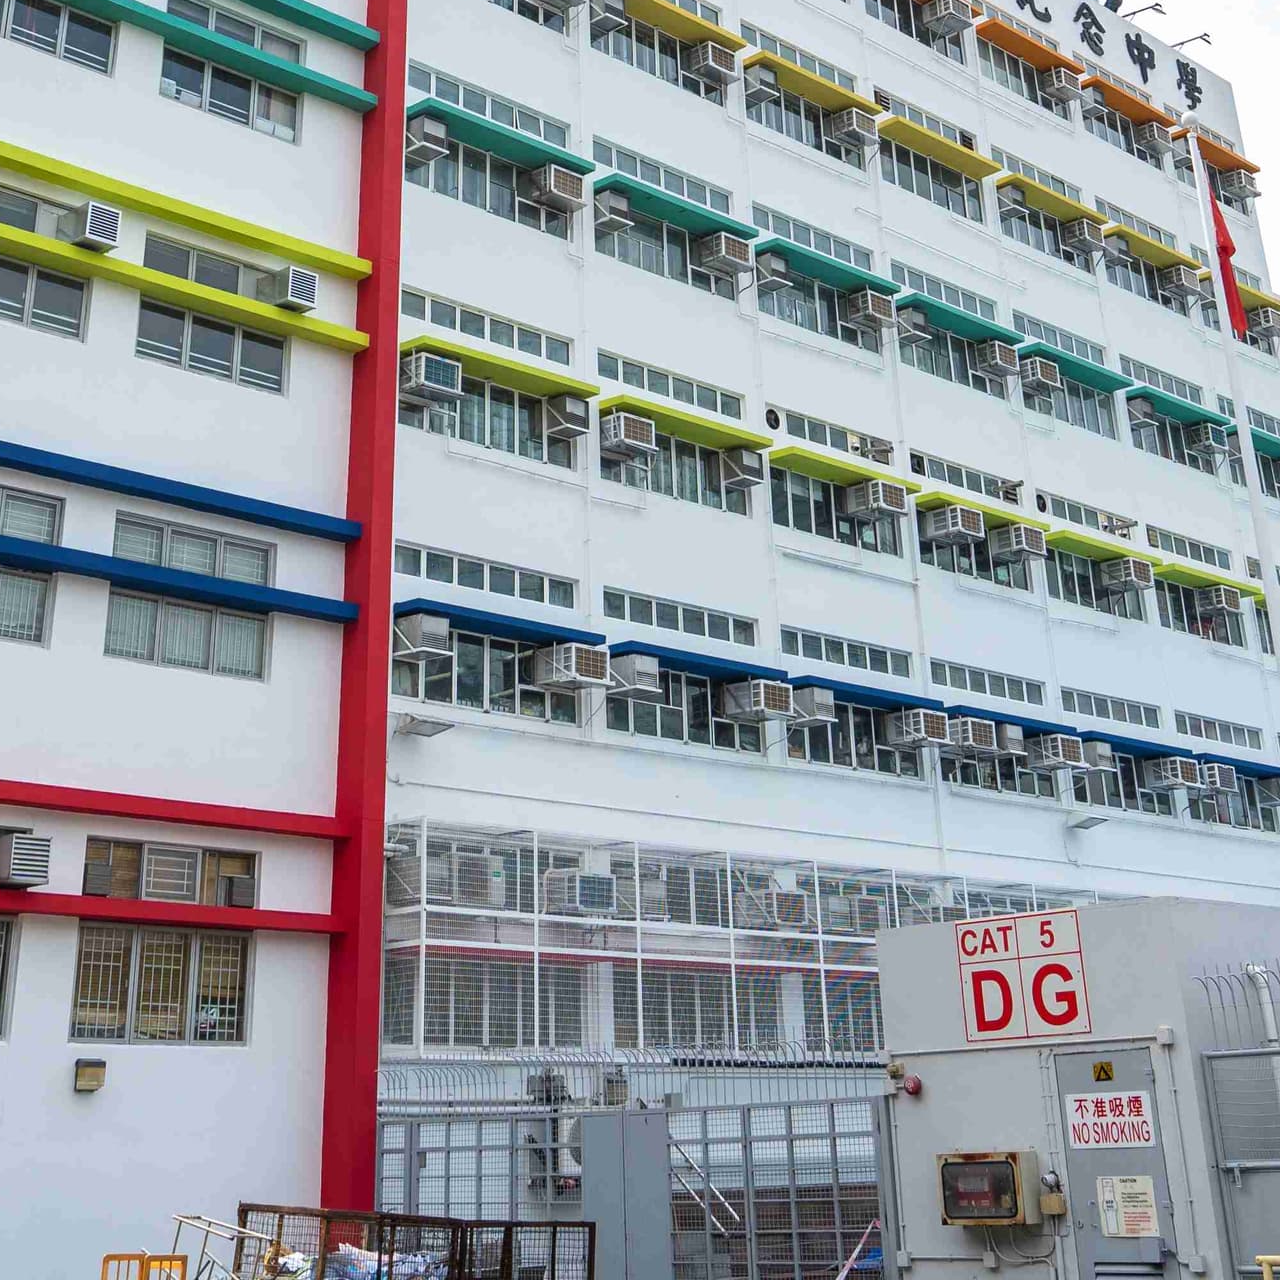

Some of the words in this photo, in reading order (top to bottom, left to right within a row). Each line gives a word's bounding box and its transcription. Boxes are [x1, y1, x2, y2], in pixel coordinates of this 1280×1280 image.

[960, 925, 1013, 957] CAT
[1039, 920, 1055, 949] 5
[1073, 1095, 1144, 1119] 不准吸煙
[1072, 1122, 1090, 1145] NO
[1093, 1120, 1151, 1144] SMOKING
